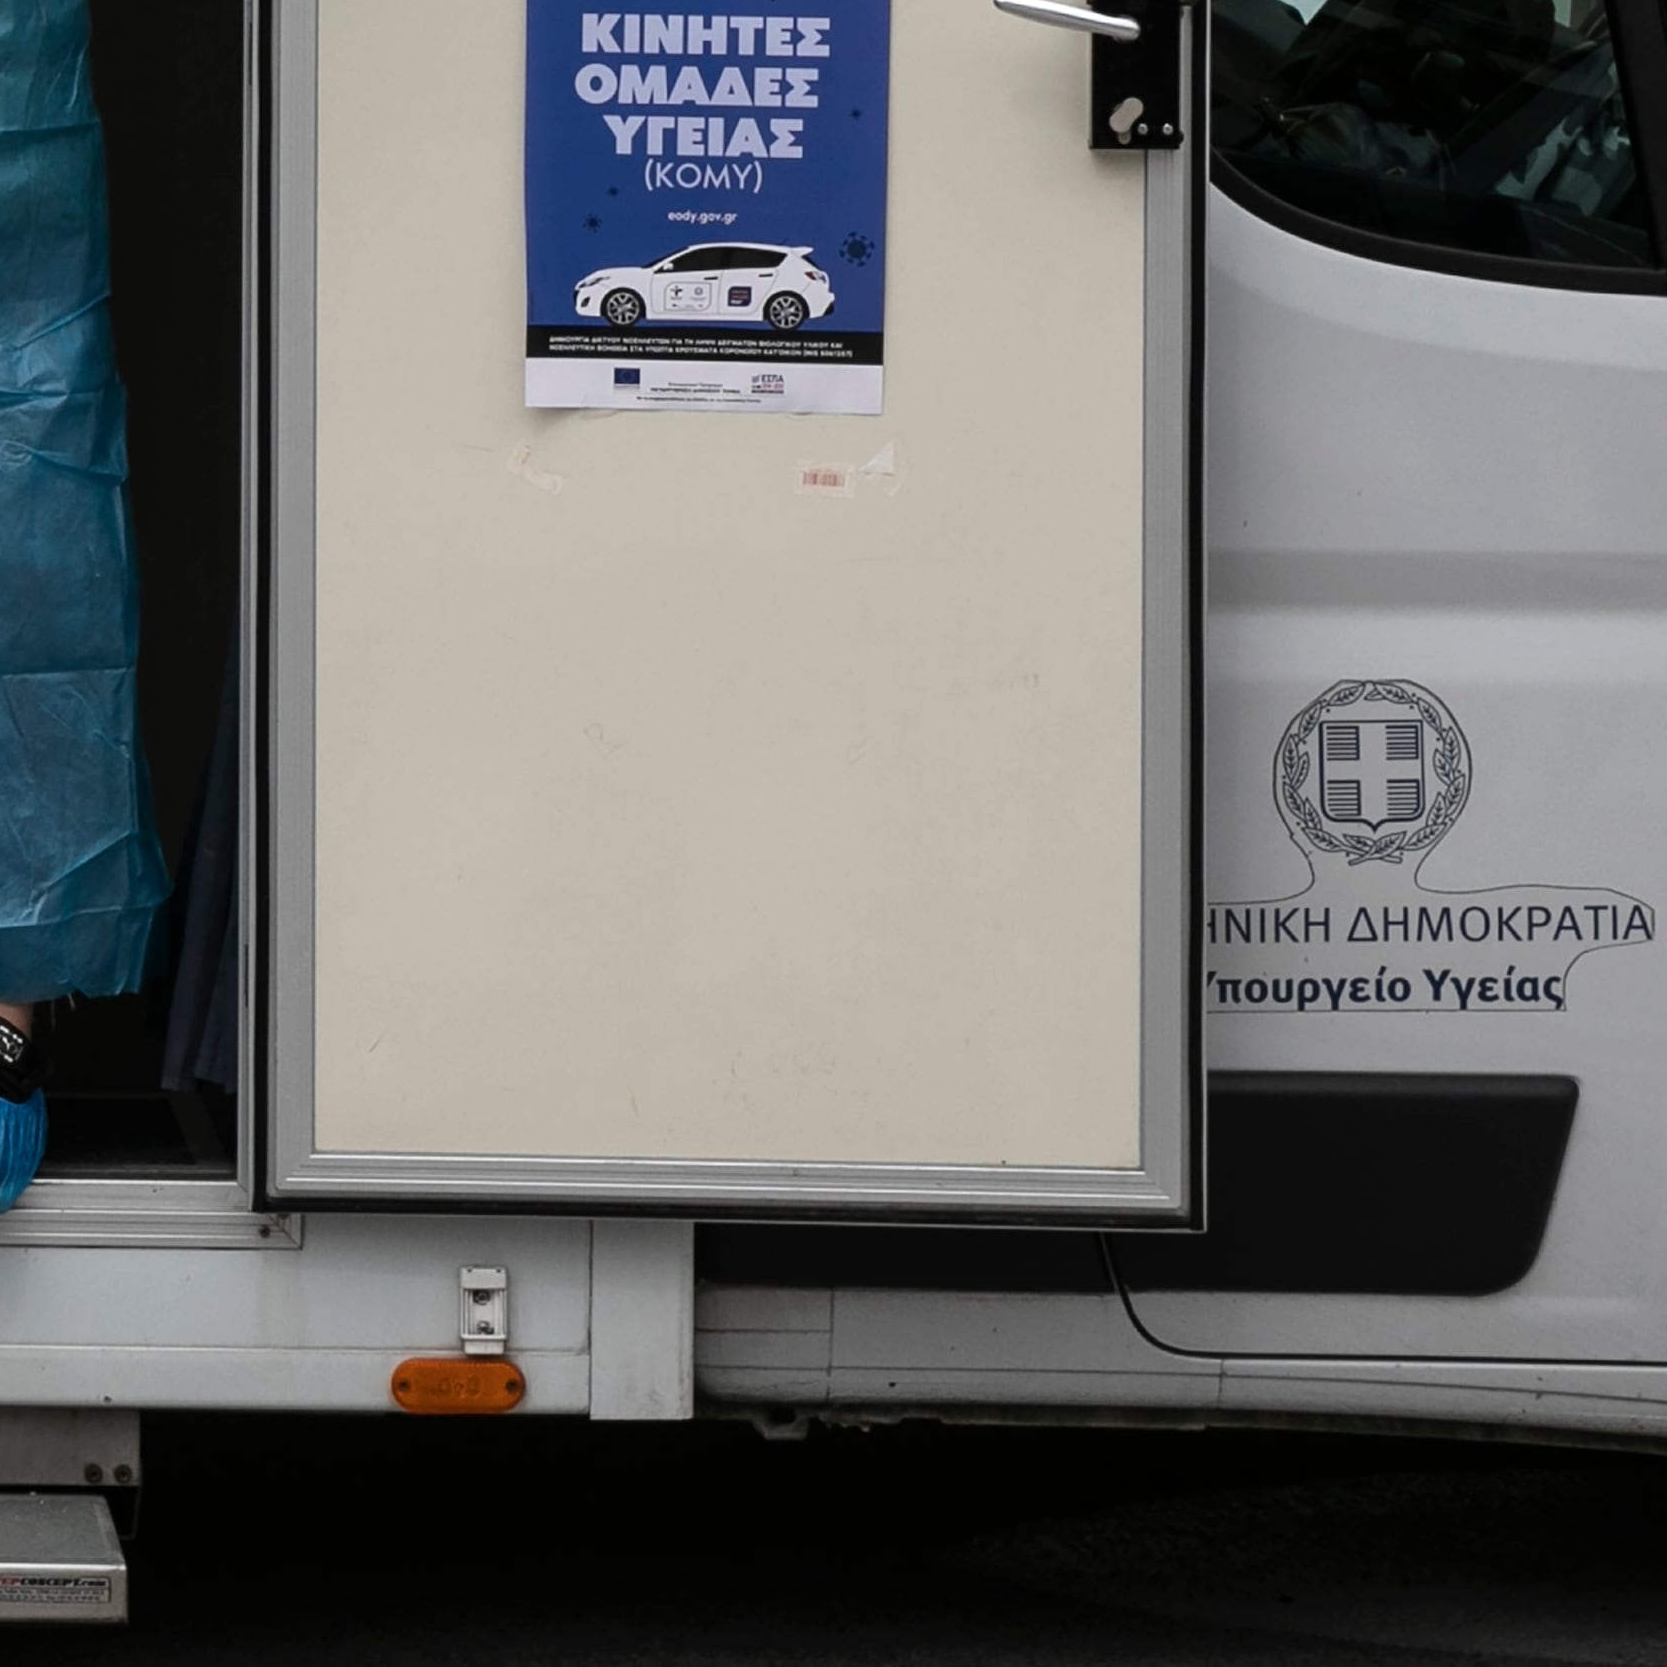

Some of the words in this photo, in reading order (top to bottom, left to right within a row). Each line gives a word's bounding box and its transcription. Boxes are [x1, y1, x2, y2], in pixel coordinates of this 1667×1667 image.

[581, 13, 831, 57] ΚΙΝΗΤΕΣ
[574, 63, 819, 108] ΟΜΑΔΕΣ
[602, 115, 804, 158] ΥΓΕΙΑΣ
[644, 160, 763, 194] (ΚΟΜΥ)
[667, 209, 738, 225] eody.gov.gr
[1347, 904, 1655, 943] ΔΗΜΟΚΡΑΤΙΑ
[1422, 965, 1565, 1012] Υγείας
